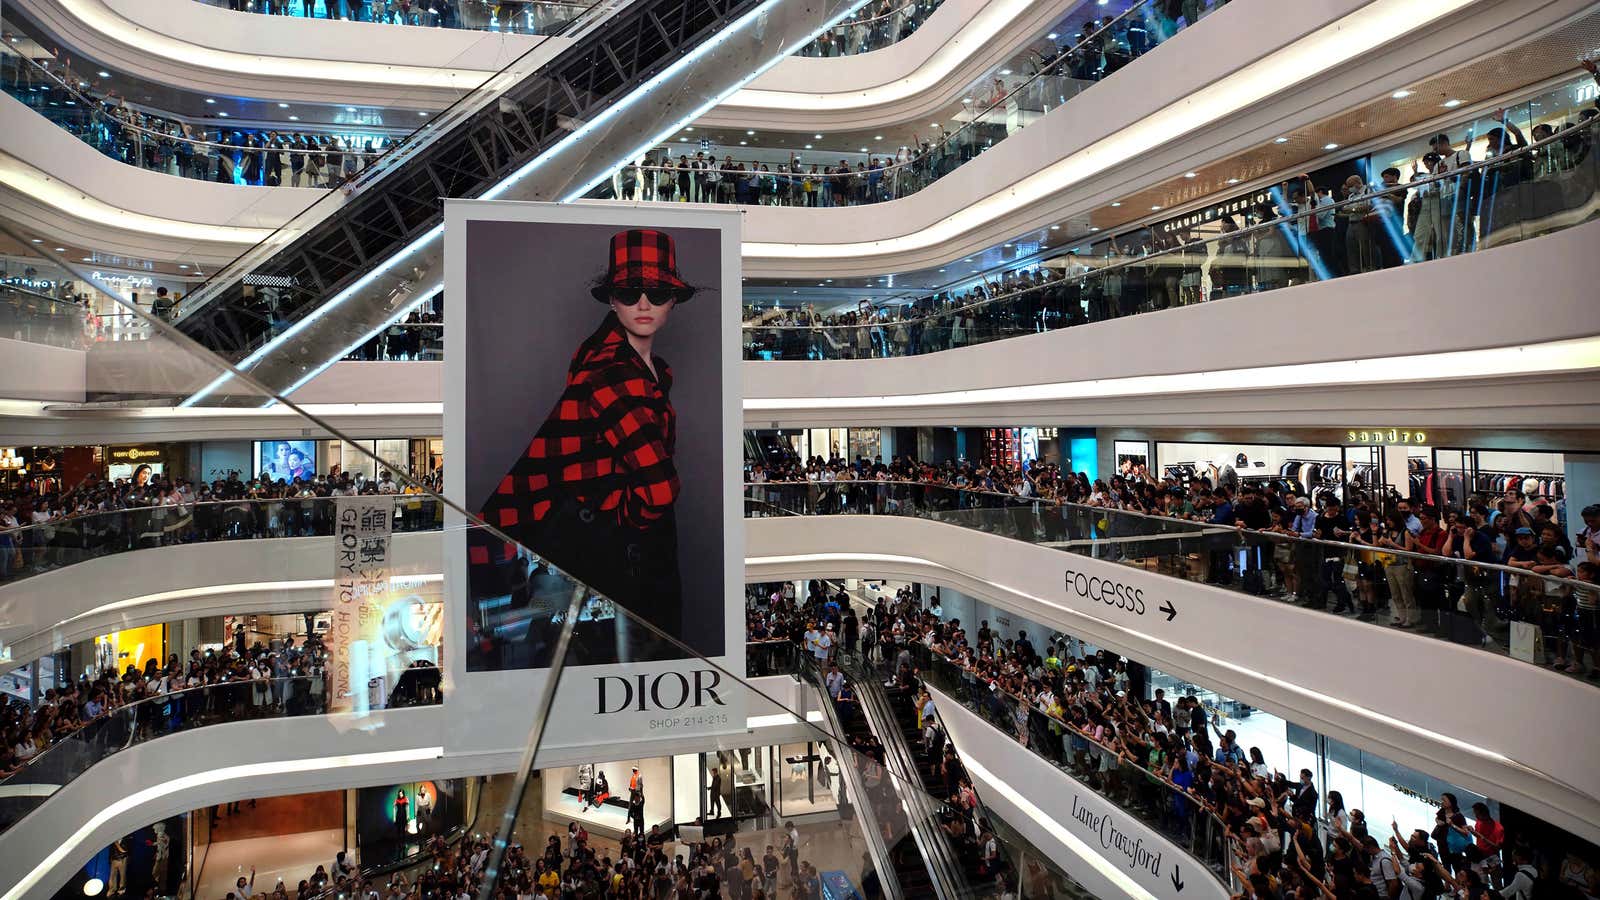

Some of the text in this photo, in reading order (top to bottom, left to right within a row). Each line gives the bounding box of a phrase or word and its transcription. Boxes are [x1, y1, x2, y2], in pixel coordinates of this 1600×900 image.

[1164, 210, 1212, 232] CLAUDIE
[1347, 429, 1426, 443] sandro
[336, 508, 358, 700] GLORY TO HONG KONG
[593, 669, 727, 715] DIOR
[649, 714, 728, 730] SHOP 214-215
[1071, 794, 1162, 878] Lane Crawford
